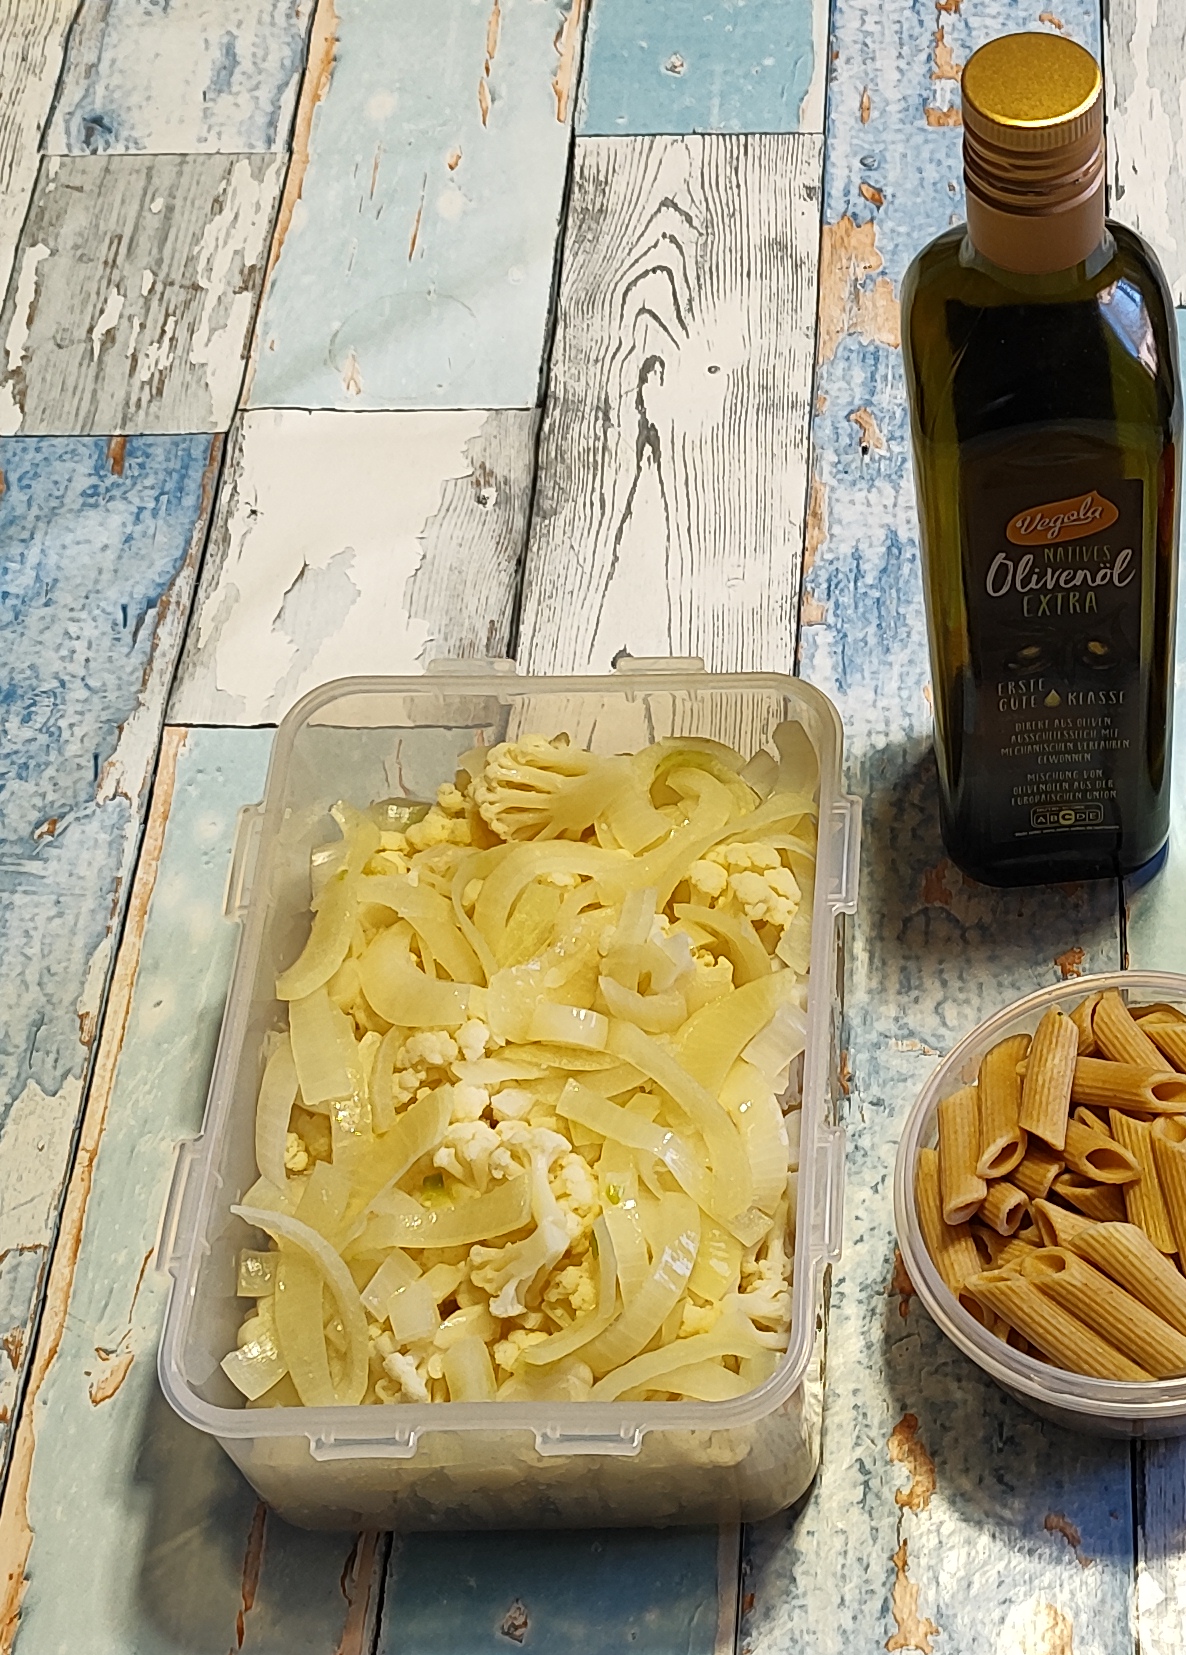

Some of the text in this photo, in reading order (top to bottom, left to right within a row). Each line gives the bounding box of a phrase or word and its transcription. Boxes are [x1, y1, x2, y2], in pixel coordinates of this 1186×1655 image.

[1016, 497, 1102, 539] Vegola
[1044, 545, 1112, 563] NATIVES
[986, 549, 1136, 597] Olivenöl
[1023, 591, 1098, 618] EXTRA
[998, 678, 1046, 697] ERSTE
[999, 690, 1126, 712] GÜTE KLASSE
[1015, 716, 1112, 732] DIREKT AUS OLIVEN
[1101, 728, 1119, 738] MIT
[1000, 739, 1131, 757] MECHANISCHEN VERFAHREN
[1037, 752, 1092, 765] GEWONNEN
[1027, 769, 1103, 782] MISCHUNG VON
[1073, 780, 1092, 790] AUS
[1096, 779, 1114, 788] DER
[1087, 790, 1117, 800] UNION
